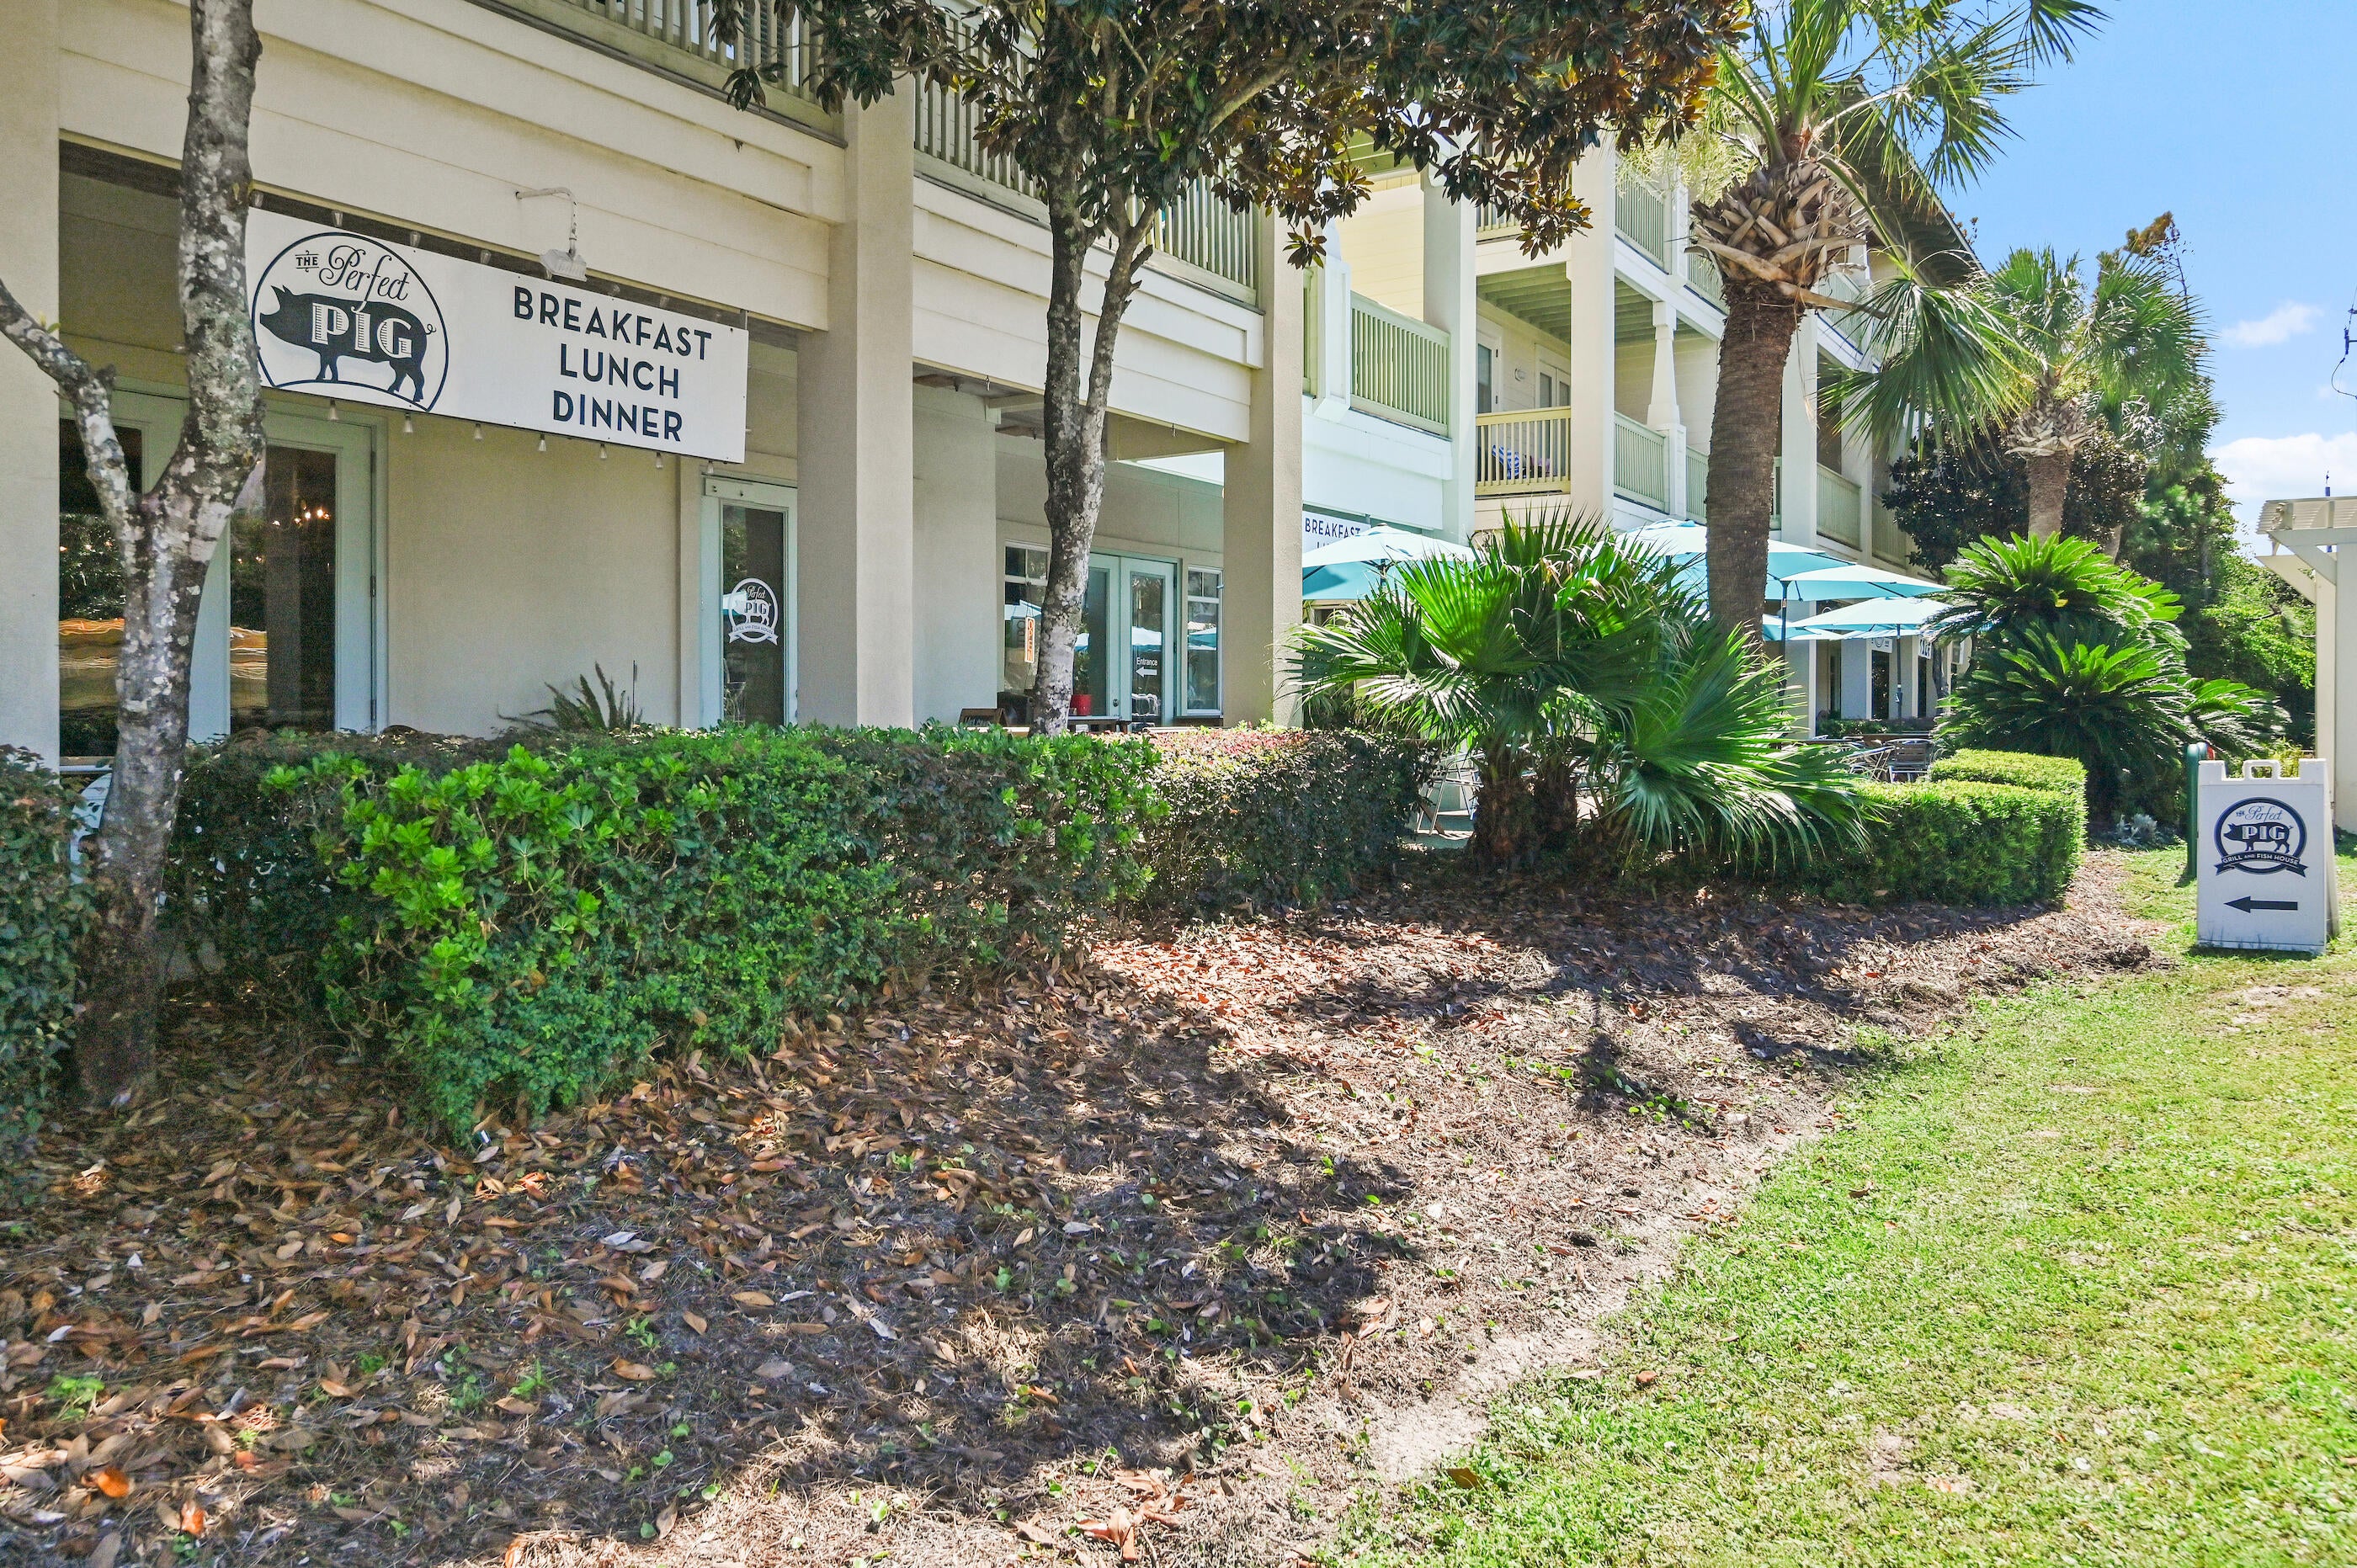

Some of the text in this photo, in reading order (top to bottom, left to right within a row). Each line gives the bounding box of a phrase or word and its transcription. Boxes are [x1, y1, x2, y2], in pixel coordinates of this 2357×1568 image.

[295, 245, 410, 313] THE Perfect
[311, 302, 412, 359] PIG
[513, 285, 712, 360] BREAKFAST
[560, 343, 679, 399] LUNCH
[552, 390, 683, 443] DINNER
[744, 603, 767, 614] PIG
[1136, 656, 1158, 666] Entrance
[2245, 805, 2283, 822] Perfect
[2242, 825, 2285, 840] PIG
[2222, 854, 2243, 864] GRILL
[2274, 854, 2300, 865] HOUSE
